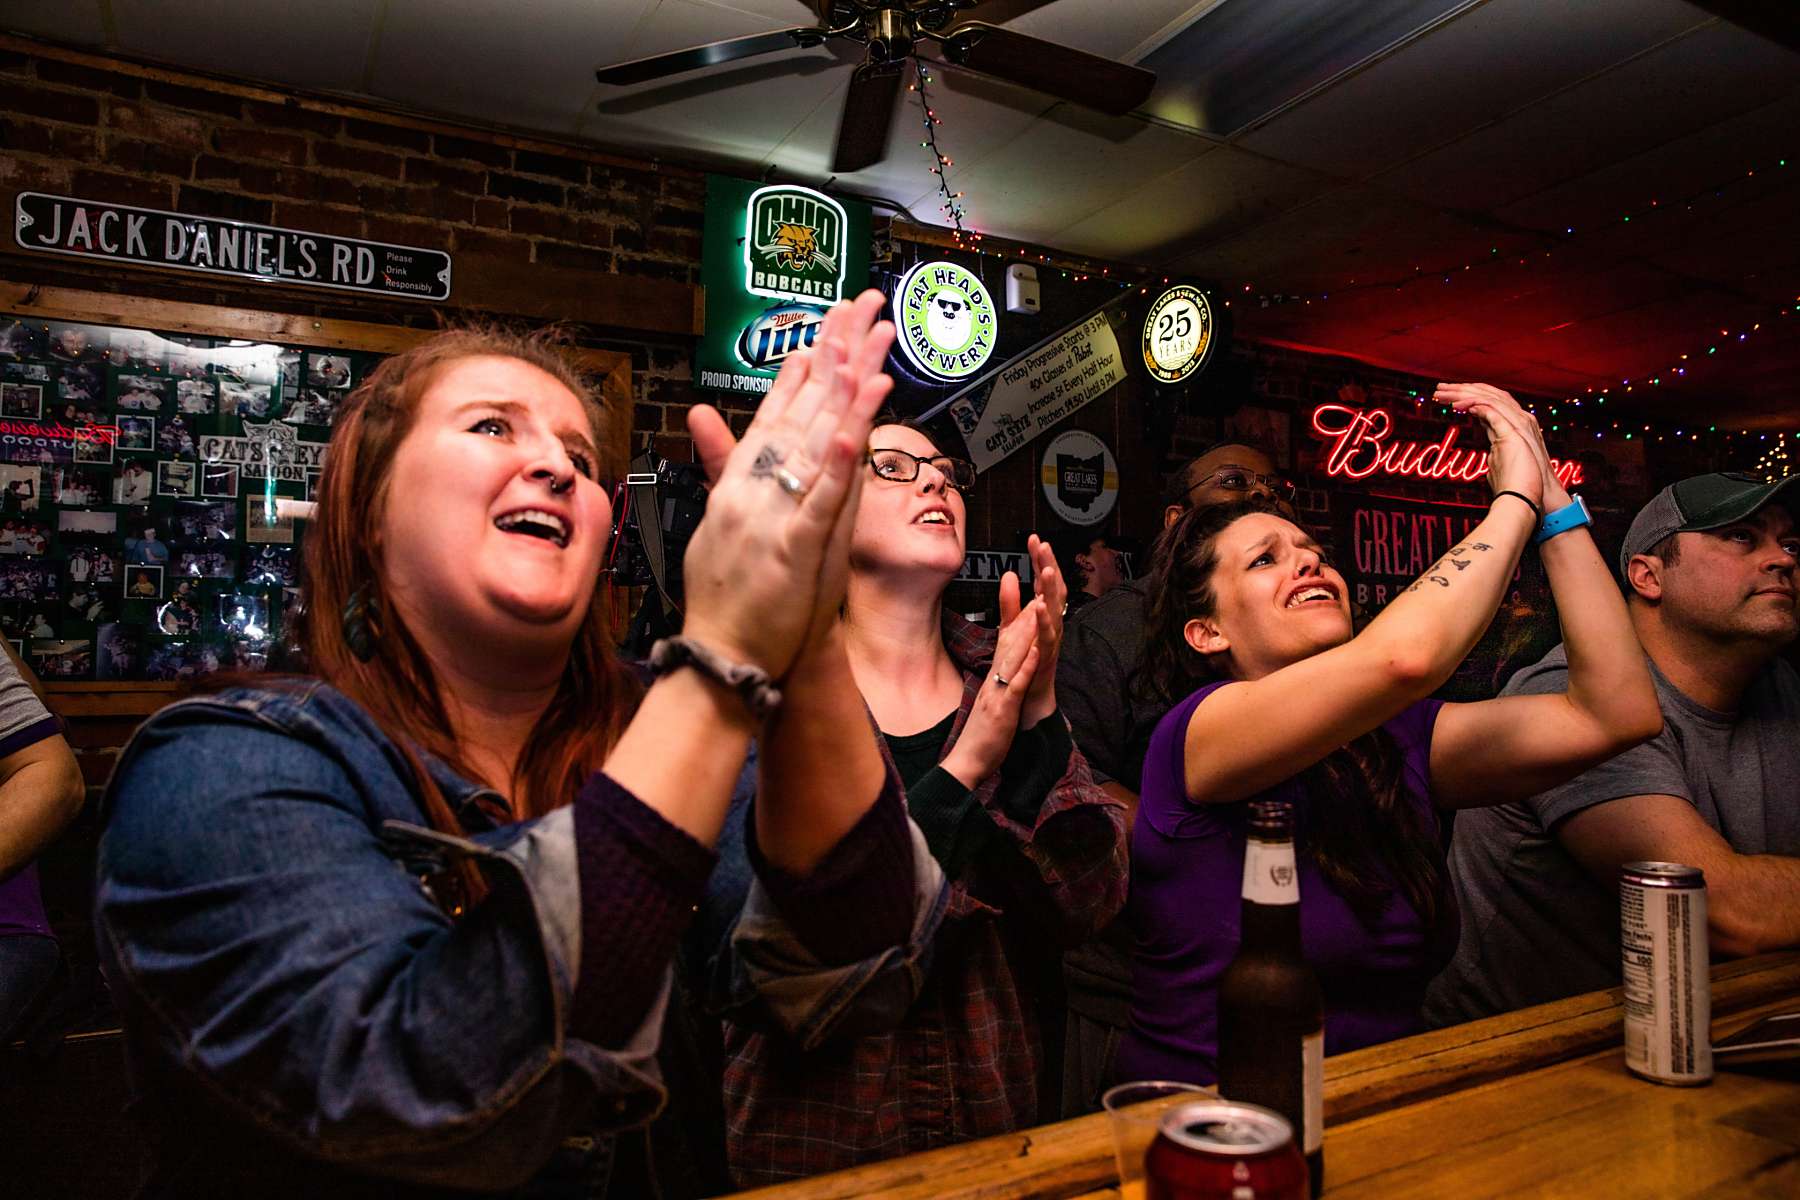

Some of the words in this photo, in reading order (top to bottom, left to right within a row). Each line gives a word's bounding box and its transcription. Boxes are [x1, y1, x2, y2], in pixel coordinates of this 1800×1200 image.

[755, 194, 840, 260] OHIO
[38, 204, 148, 257] JACK
[165, 219, 318, 278] DANIEL'S
[332, 243, 375, 285] RD
[386, 252, 414, 264] Please
[386, 265, 408, 277] Drink
[754, 271, 834, 298] BOBCATS
[385, 278, 433, 294] Responsibly
[909, 276, 930, 310] FAT
[934, 269, 991, 324] HEAD'S
[771, 312, 809, 327] Miller
[1145, 311, 1157, 339] GREAT
[1156, 291, 1176, 311] LAKES
[1159, 307, 1192, 345] 25
[910, 325, 988, 370] BREWERY
[1002, 367, 1029, 386] Friday
[1026, 342, 1066, 371] Progressive
[1063, 330, 1085, 349] Starts
[1090, 321, 1097, 333] 3
[1159, 337, 1193, 359] YEARS
[1042, 364, 1067, 383] Glasses
[1066, 355, 1073, 369] of
[1071, 342, 1094, 364] Pabst
[1181, 359, 1196, 375] 2013
[701, 371, 731, 389] PROUD
[1027, 391, 1056, 414] Increase
[1062, 375, 1084, 393] Every
[1082, 361, 1099, 379] Half
[1098, 353, 1114, 370] Hour
[1037, 406, 1066, 429] Pitchers
[1083, 381, 1101, 400] Until
[1104, 369, 1116, 386] PM
[203, 438, 264, 462] CATS
[295, 444, 325, 466] EY
[985, 430, 1008, 452] CATS
[244, 463, 305, 480] SALOON
[1354, 508, 1438, 577] GREAT
[958, 553, 1022, 581] TM
